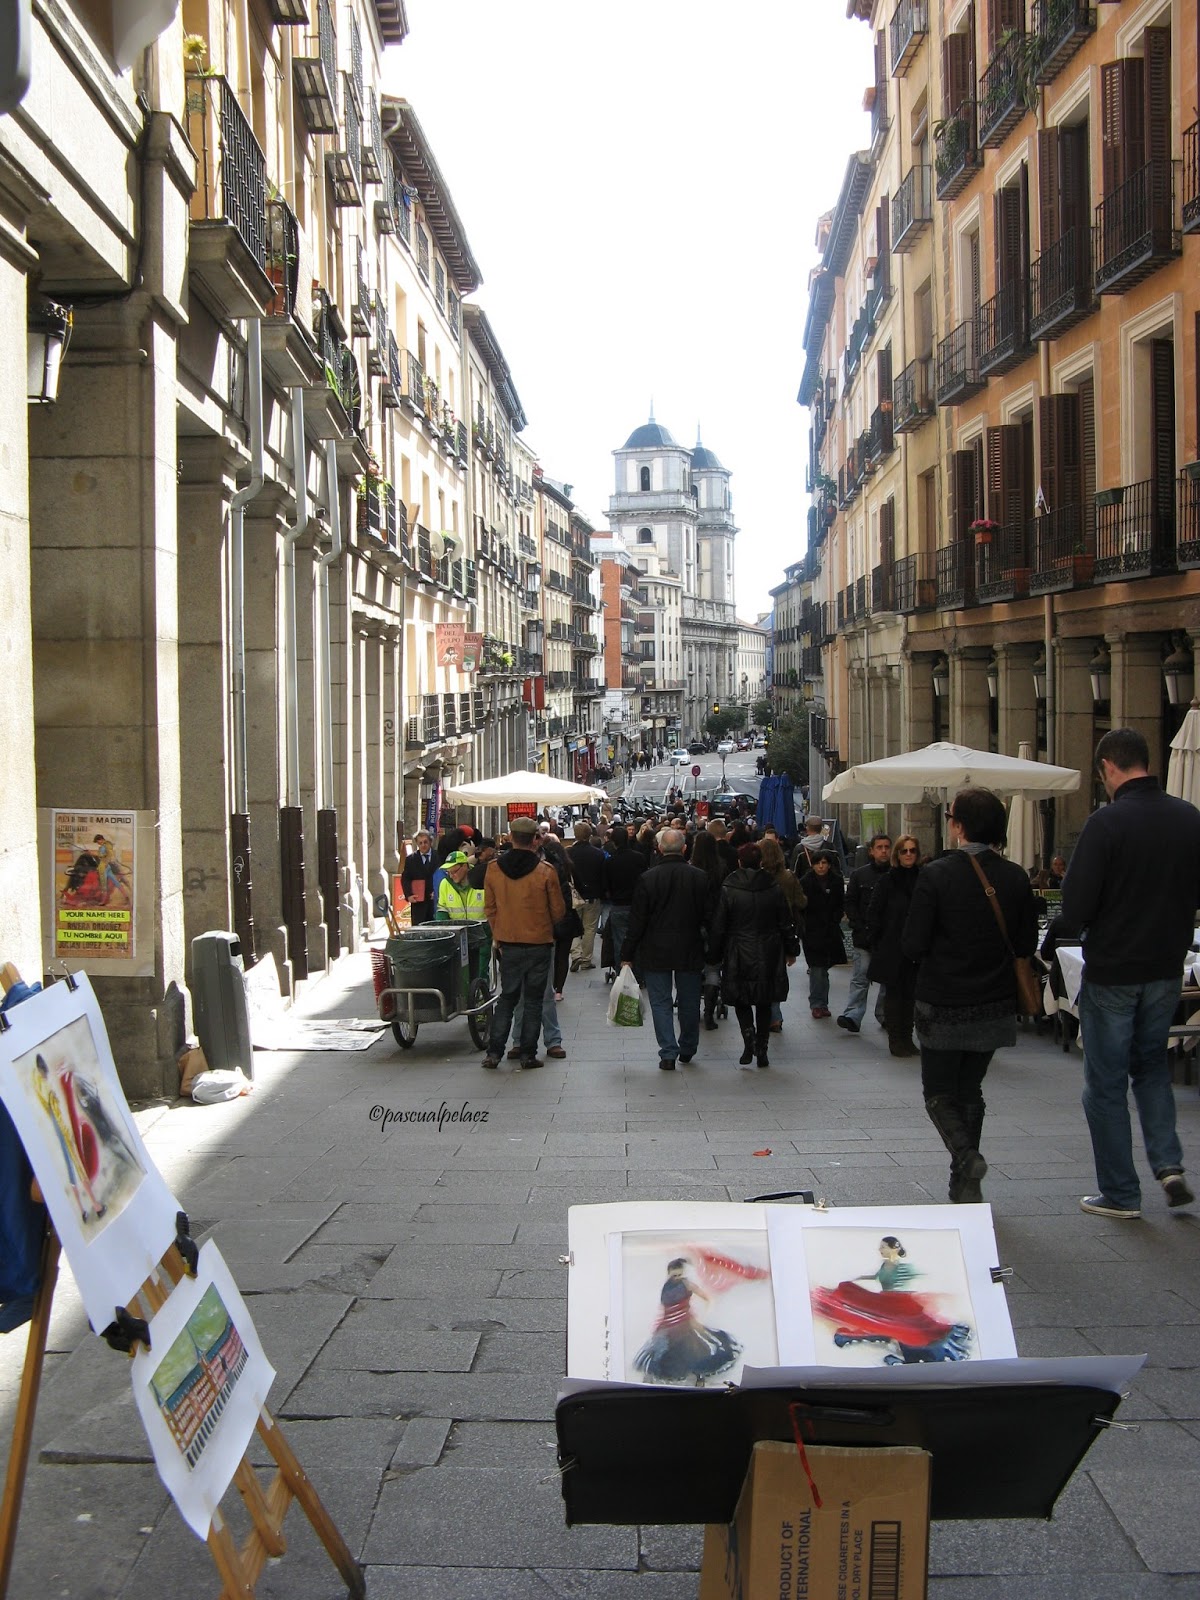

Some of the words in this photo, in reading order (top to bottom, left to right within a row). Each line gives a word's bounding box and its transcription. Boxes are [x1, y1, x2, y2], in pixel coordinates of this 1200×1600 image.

[841, 1509, 850, 1519] IN
[781, 1521, 794, 1539] OF
[796, 1507, 812, 1600] TERNATIONAL
[839, 1521, 849, 1581] CIGARETTES
[854, 1529, 863, 1560] PLACE
[779, 1543, 793, 1600] RODUCT
[853, 1564, 861, 1583] DRY
[838, 1584, 847, 1600] ESE
